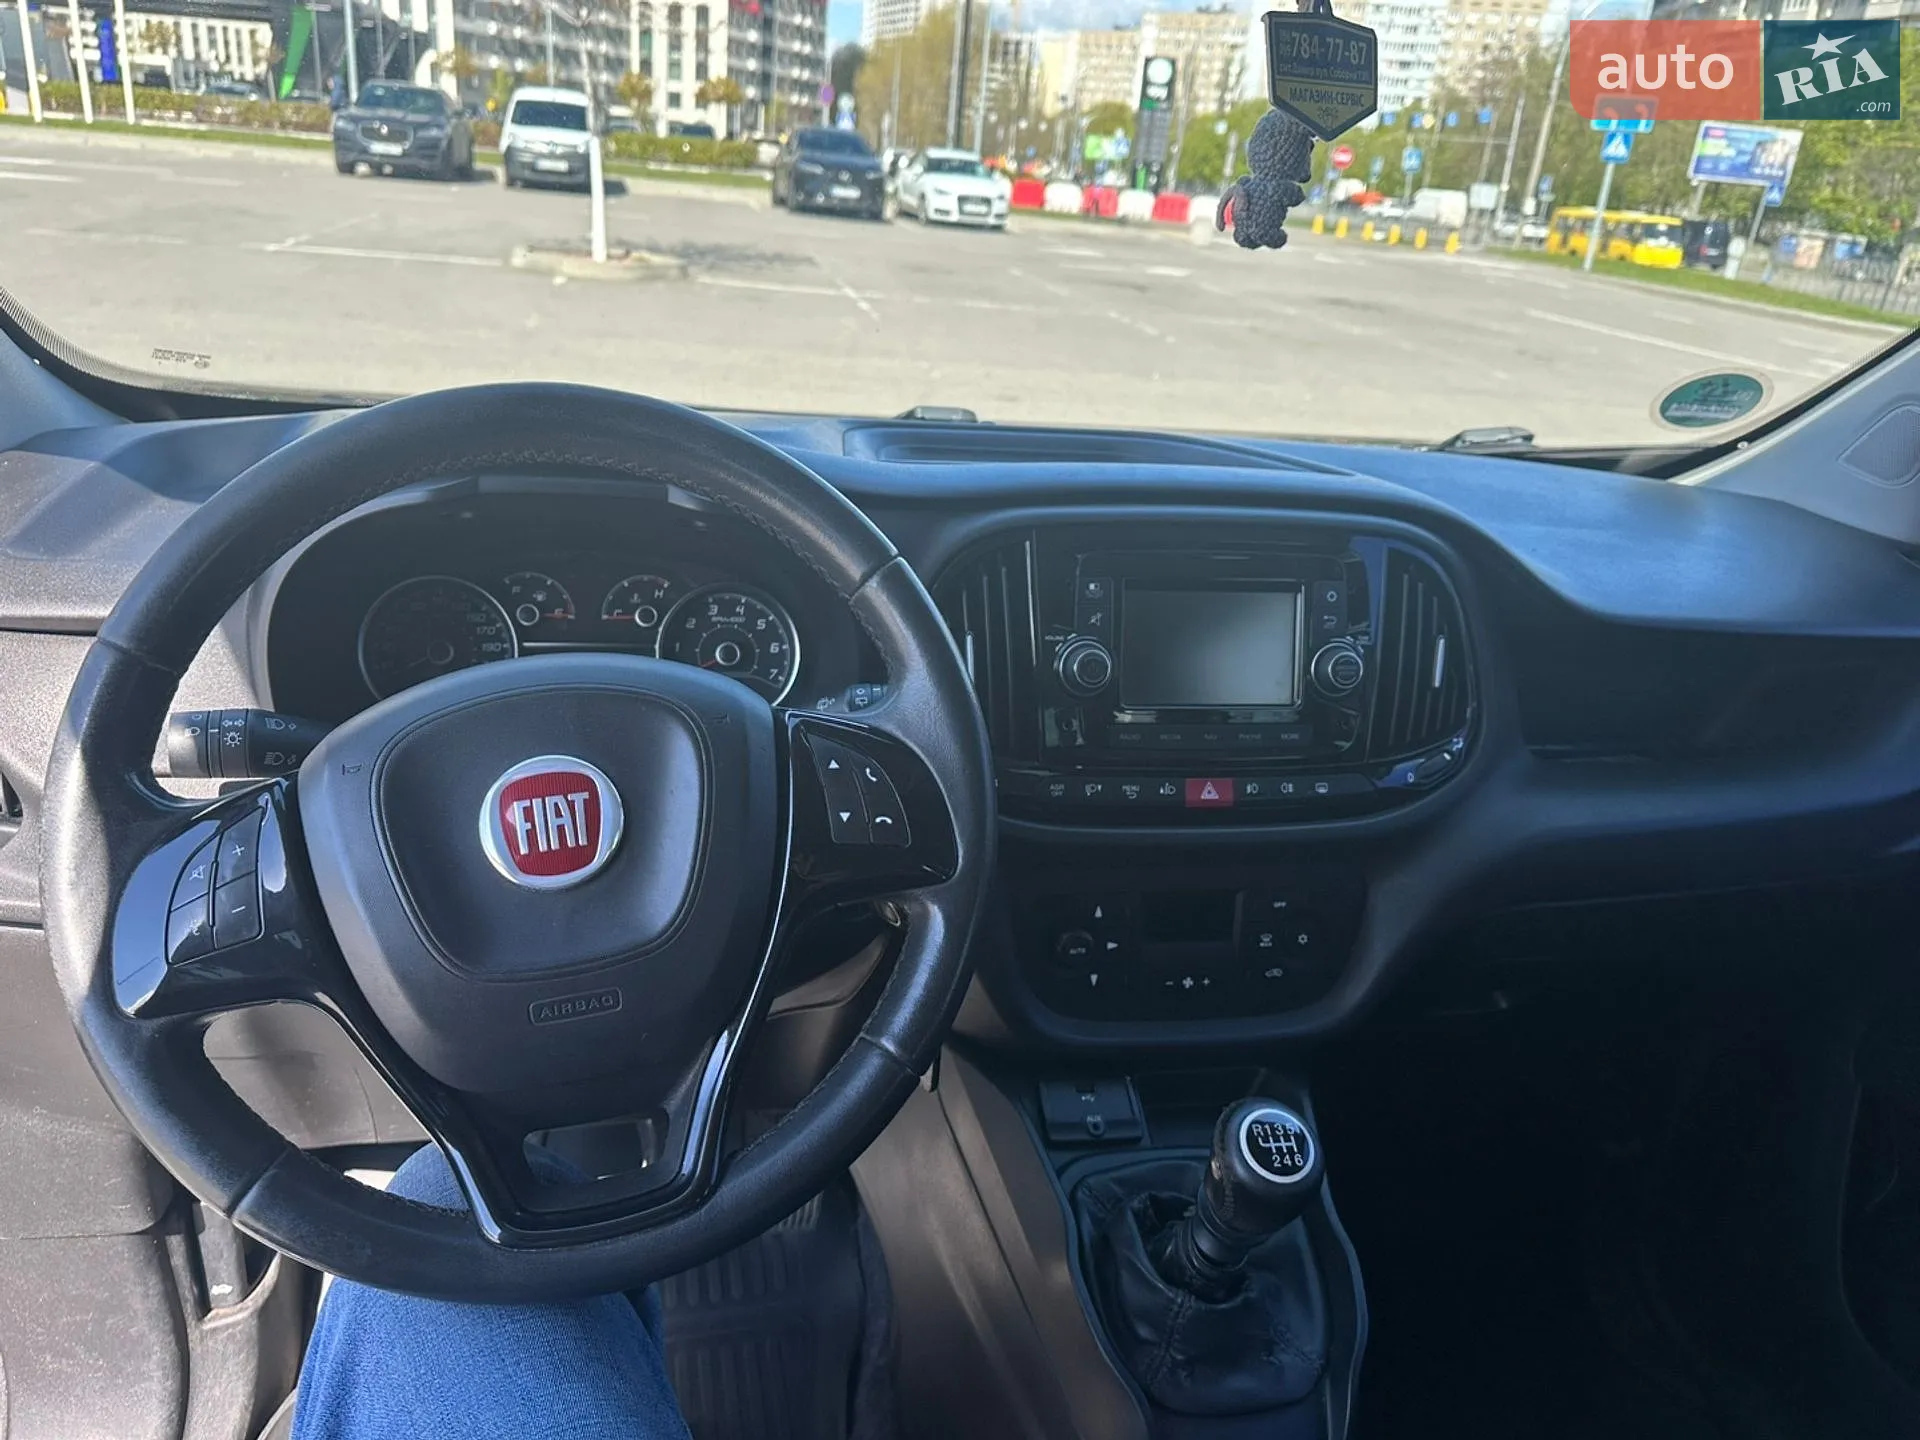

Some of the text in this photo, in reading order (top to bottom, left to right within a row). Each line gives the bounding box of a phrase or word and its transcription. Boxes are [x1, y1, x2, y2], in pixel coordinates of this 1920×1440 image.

[1291, 31, 1367, 65] 784-77-87
[654, 589, 664, 599] H
[708, 604, 718, 616] 3
[735, 605, 745, 616] 4
[686, 618, 696, 629] 2
[756, 619, 766, 630] 5
[476, 626, 496, 636] 170
[482, 642, 501, 652] 190
[770, 643, 779, 653] 6
[769, 668, 778, 680] 7
[514, 791, 589, 856] FIAT
[539, 994, 614, 1020] AIRBAG
[1251, 1123, 1264, 1137] R
[1263, 1123, 1272, 1136] 1
[1274, 1122, 1284, 1135] 3
[1271, 1153, 1304, 1167] 2 4 6
